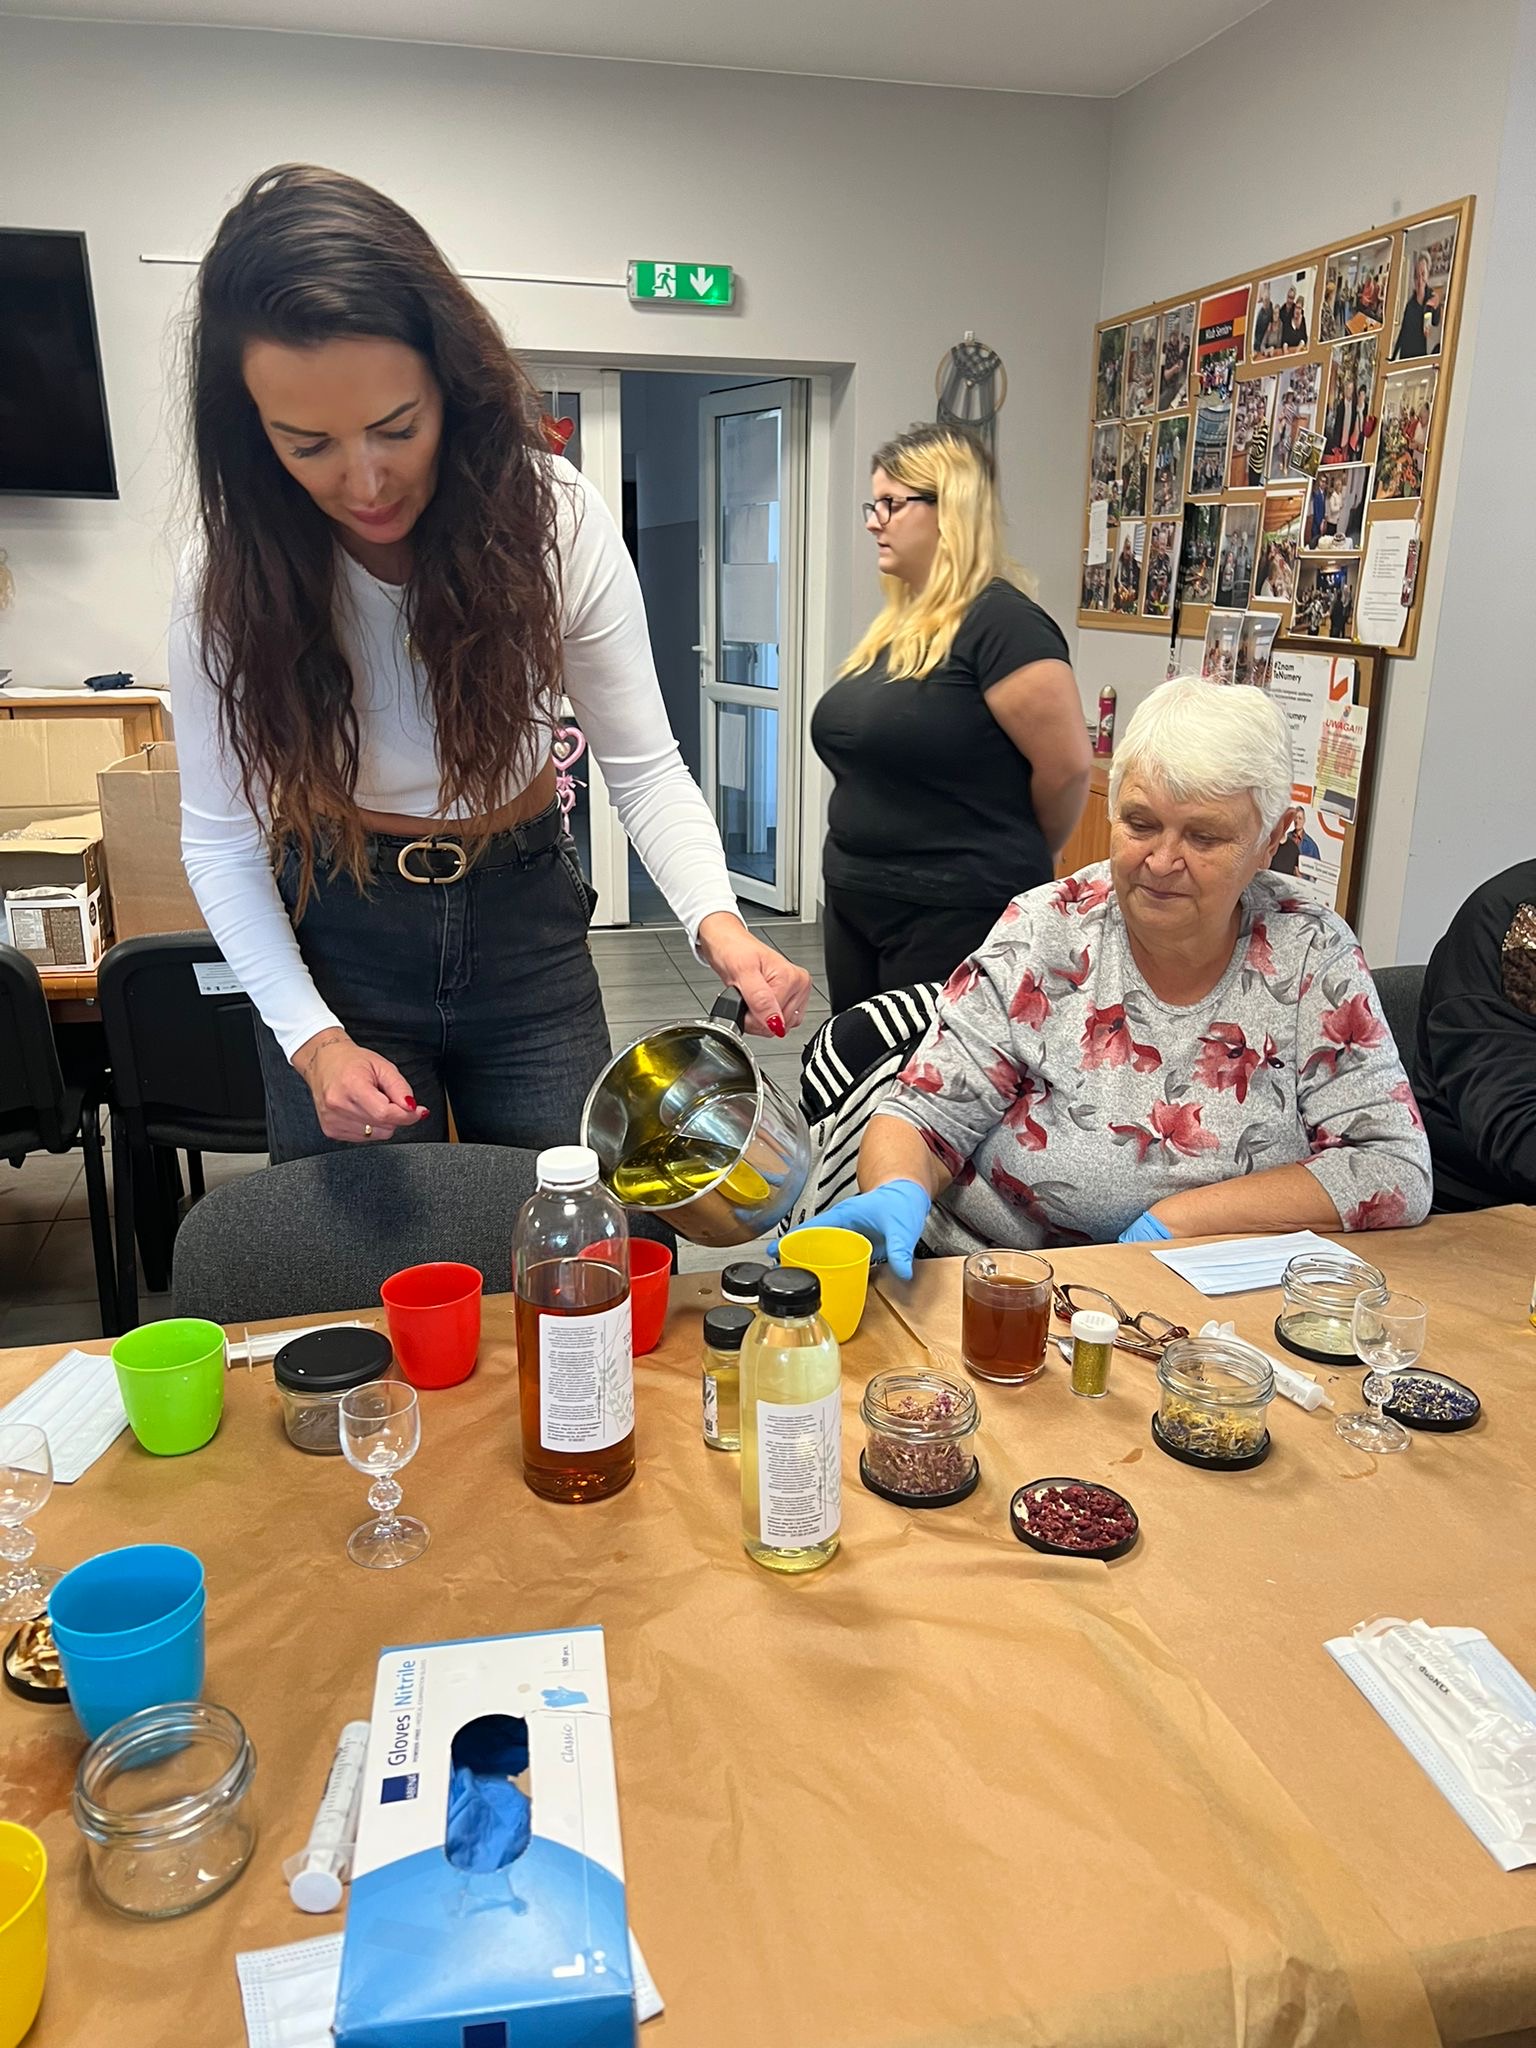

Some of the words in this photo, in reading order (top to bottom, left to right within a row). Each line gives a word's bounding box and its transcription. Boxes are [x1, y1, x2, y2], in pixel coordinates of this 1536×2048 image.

[1273, 670, 1302, 684] TeNumery
[1325, 719, 1363, 735] UWAGA!!!
[394, 1660, 416, 1706] Nitrile
[387, 1715, 411, 1766] Gloves
[560, 1724, 575, 1763] Classic
